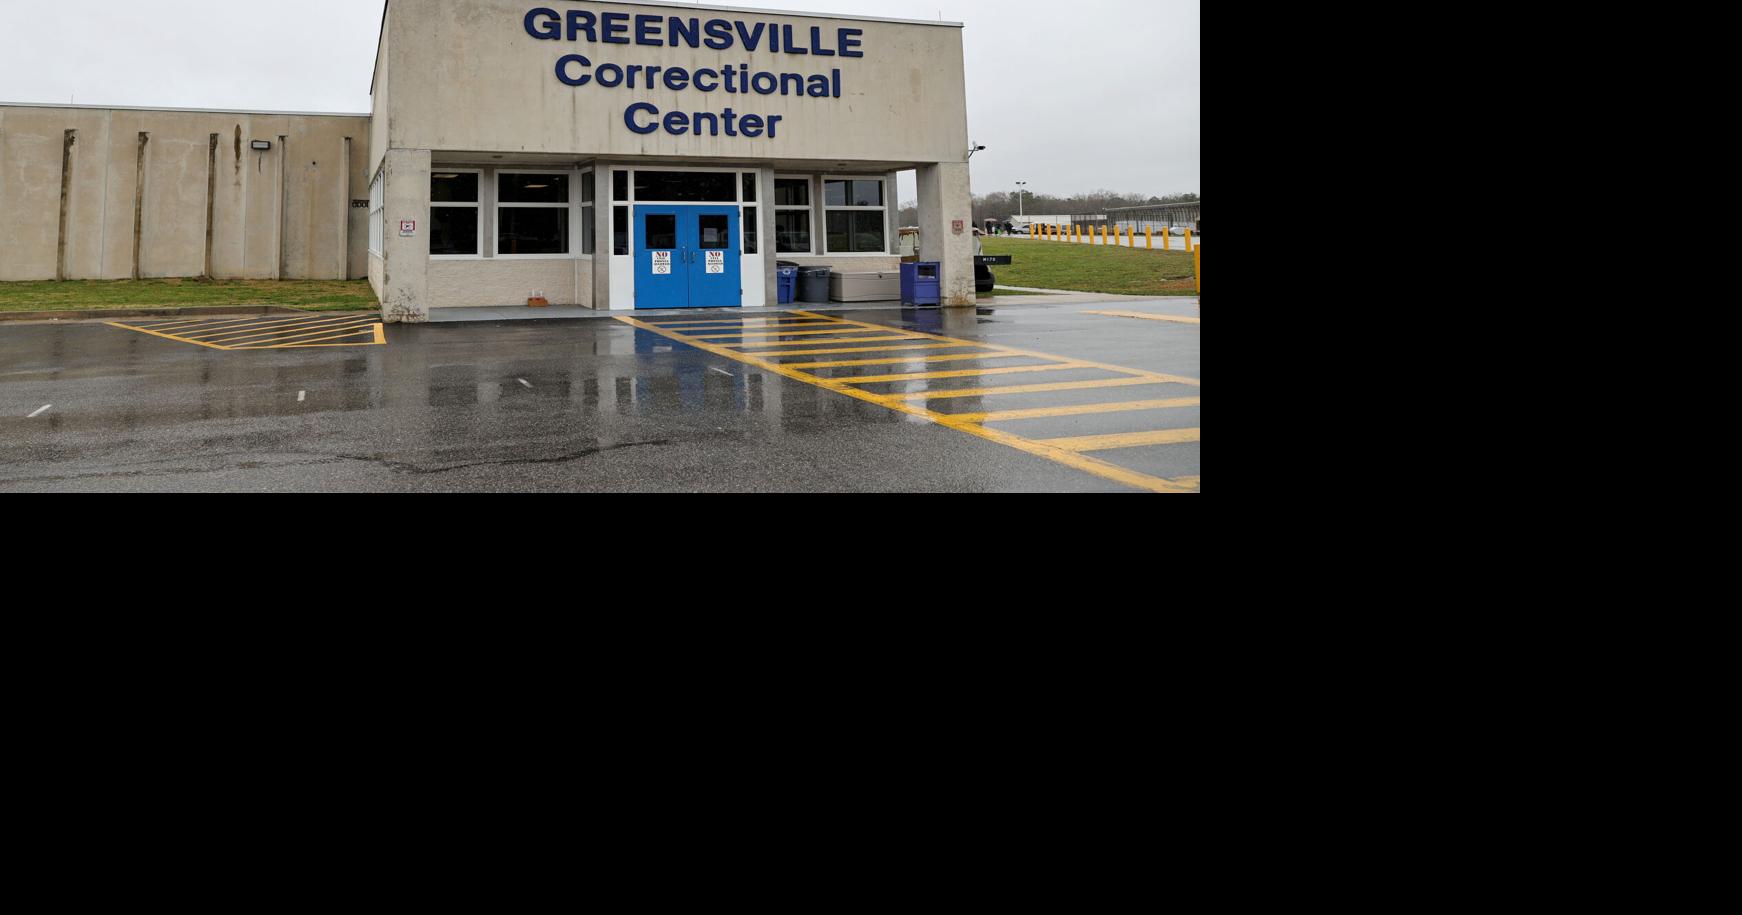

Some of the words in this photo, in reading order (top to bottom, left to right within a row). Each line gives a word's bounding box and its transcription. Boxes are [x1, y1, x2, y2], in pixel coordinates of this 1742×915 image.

[524, 8, 863, 58] GREENSVILLE
[555, 54, 841, 98] Correctional
[624, 102, 782, 138] Center
